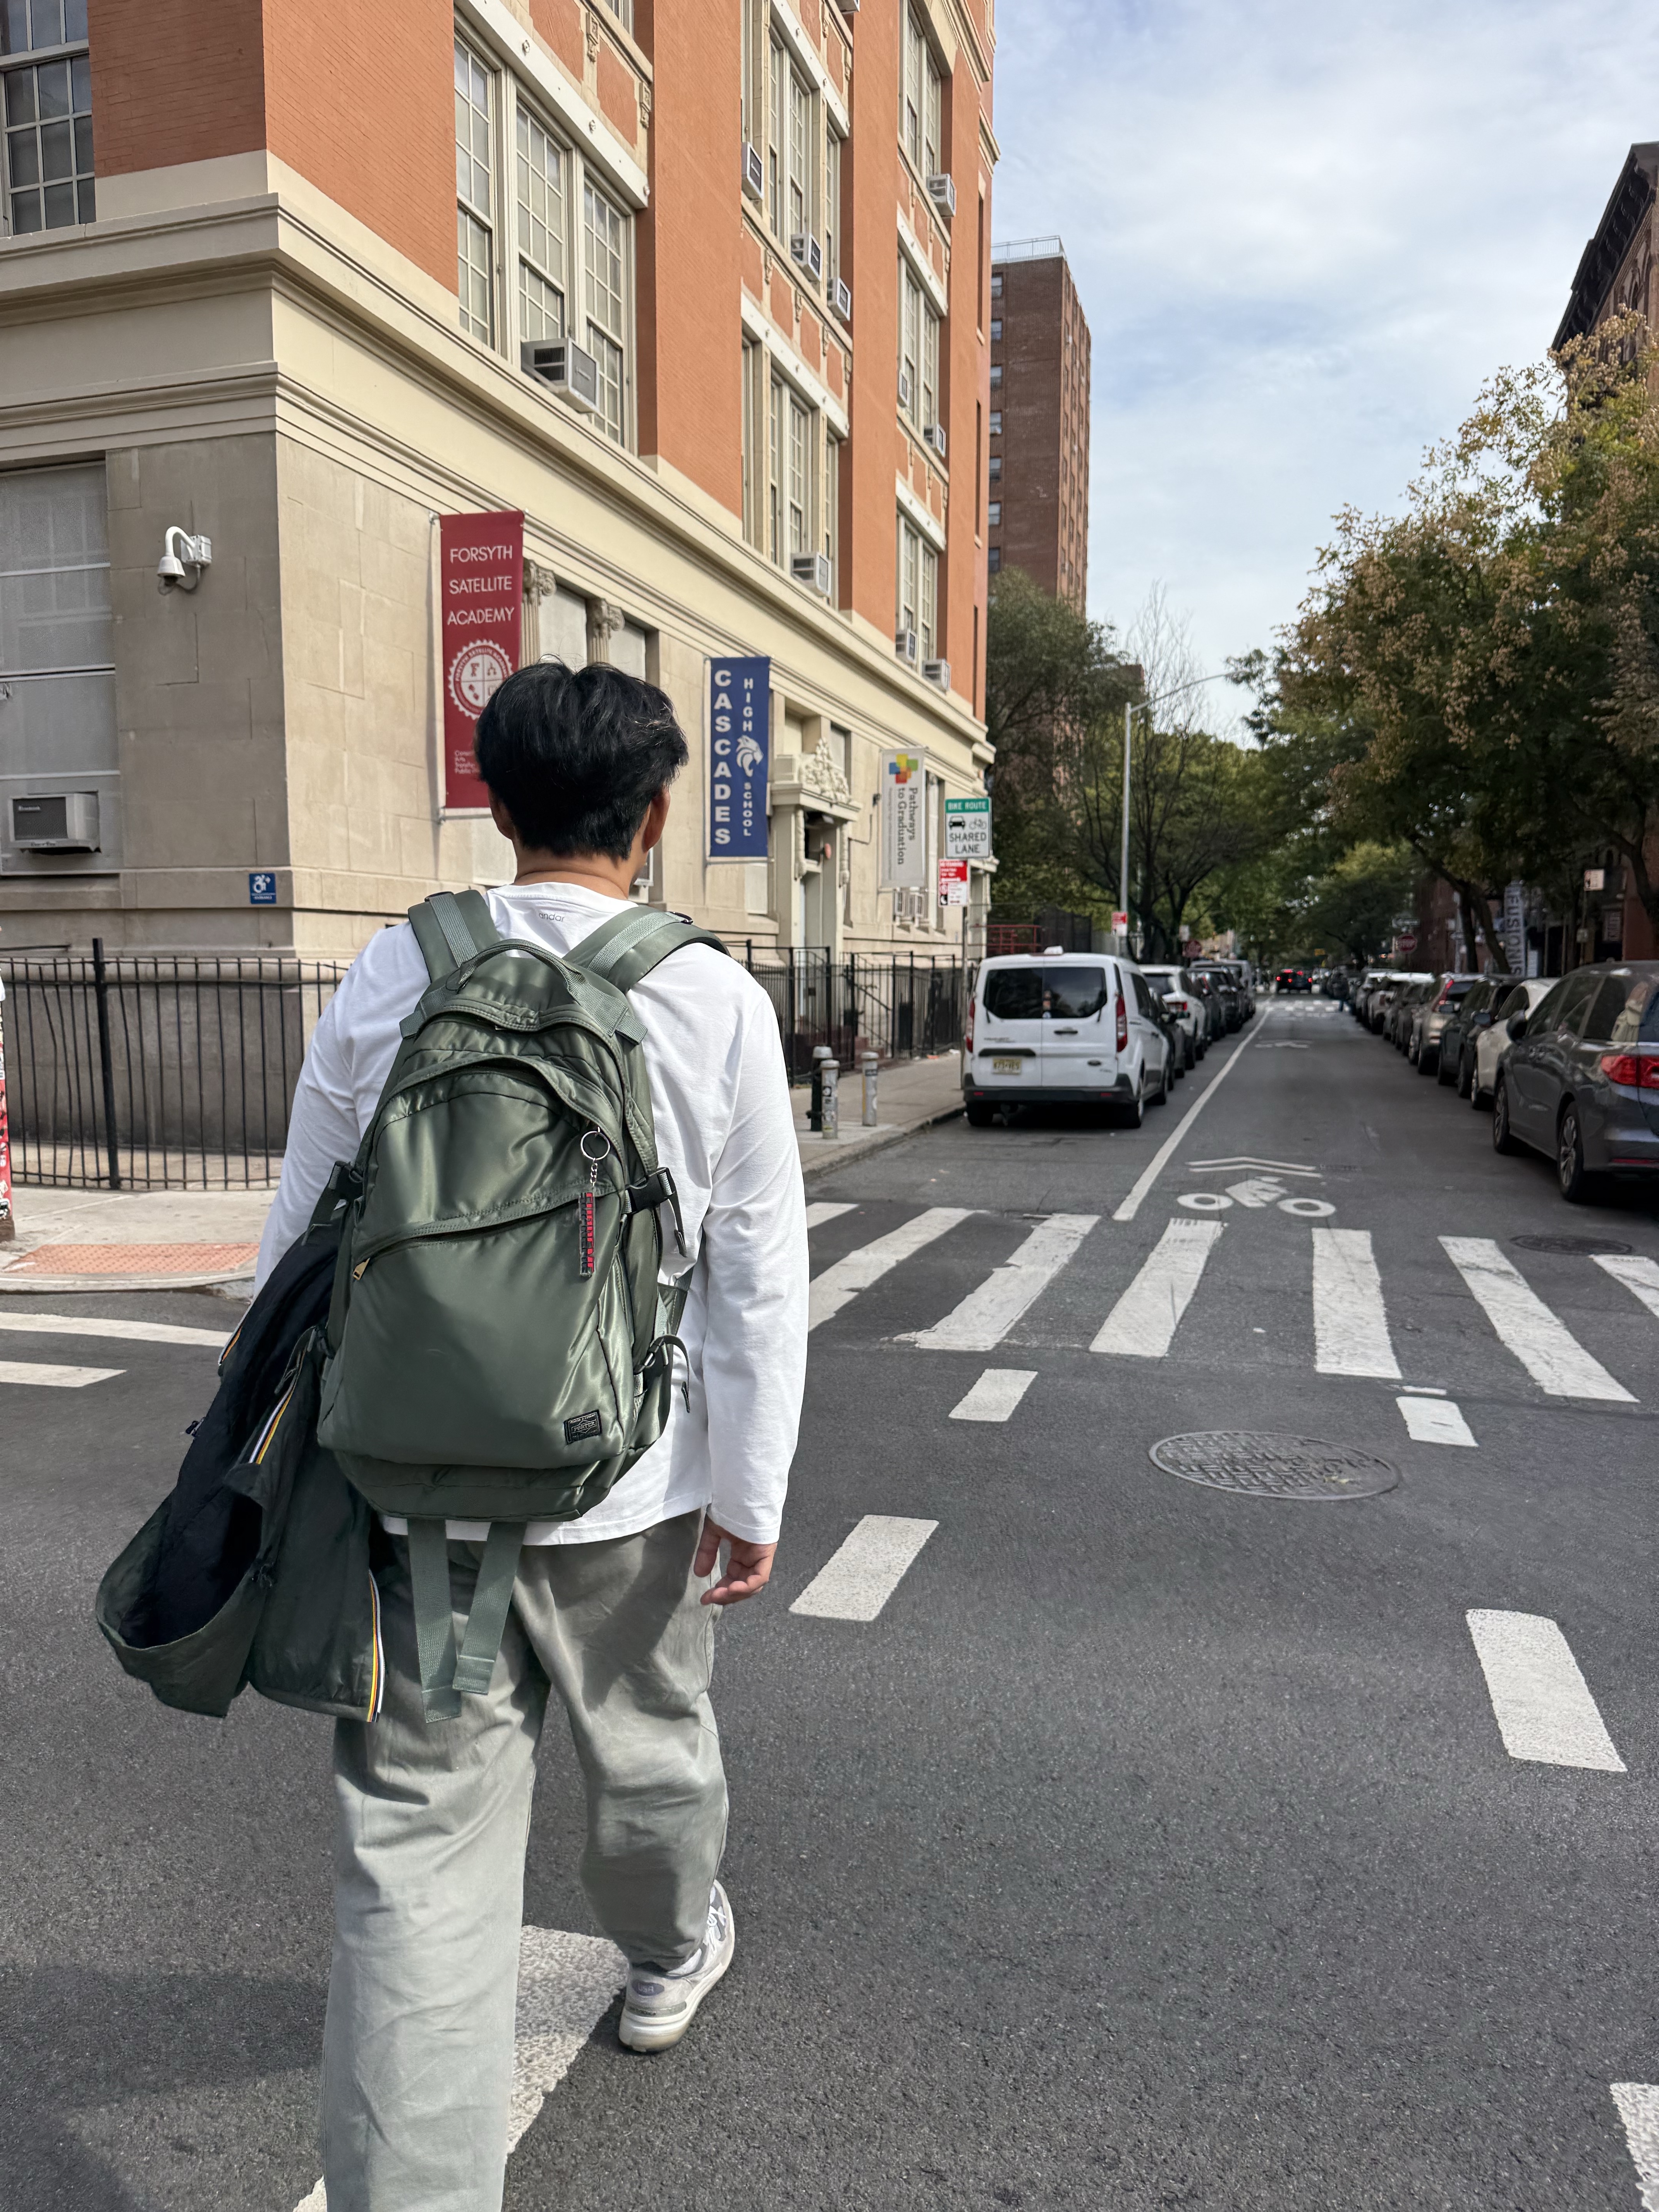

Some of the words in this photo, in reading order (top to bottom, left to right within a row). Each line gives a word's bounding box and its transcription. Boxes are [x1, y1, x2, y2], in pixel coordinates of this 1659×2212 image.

[450, 545, 513, 563] FORSYTH
[449, 576, 512, 594] SATELLITE
[447, 606, 515, 625] ACADEMY
[743, 678, 754, 732] HIGH
[714, 670, 732, 845] CASCADES
[897, 787, 905, 799] to
[743, 782, 753, 836] SCHOOL
[907, 787, 918, 841] Pathways
[948, 802, 962, 811] BIKE
[965, 801, 986, 810] ROUTE
[897, 801, 907, 865] Graduation
[949, 832, 987, 842] SHARED
[955, 844, 980, 854] LANE
[539, 912, 565, 922] andar
[574, 1422, 595, 1432] PORTER
[639, 1982, 654, 1993] USA
